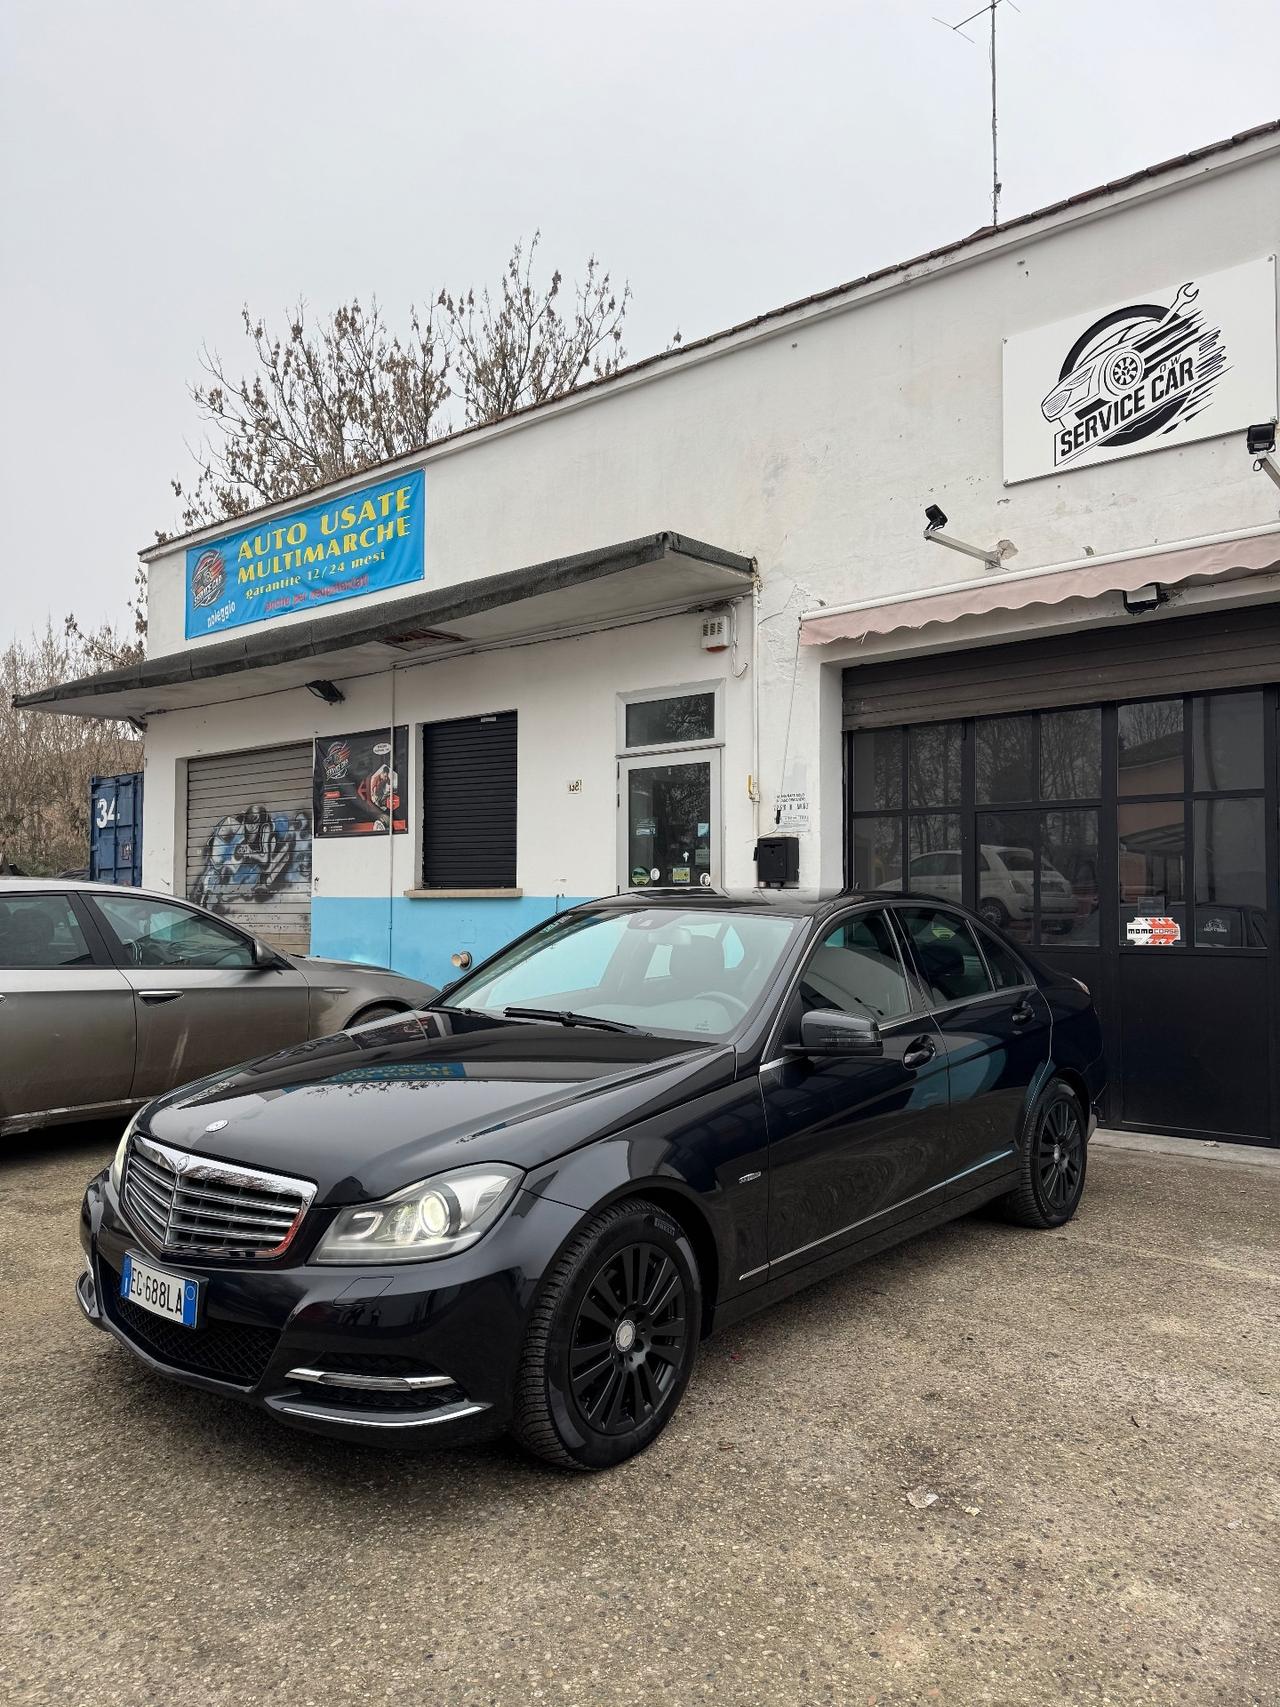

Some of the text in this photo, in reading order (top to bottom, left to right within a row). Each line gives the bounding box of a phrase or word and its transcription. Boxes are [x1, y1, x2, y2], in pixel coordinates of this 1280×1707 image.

[1060, 357, 1195, 457] SERVICE CAR
[238, 486, 411, 562] AUTO USATE
[238, 516, 411, 584] MULTIMARCHE
[246, 548, 386, 600] garantite 12/24 mesi
[207, 600, 236, 629] noleggio
[96, 797, 121, 829] 34
